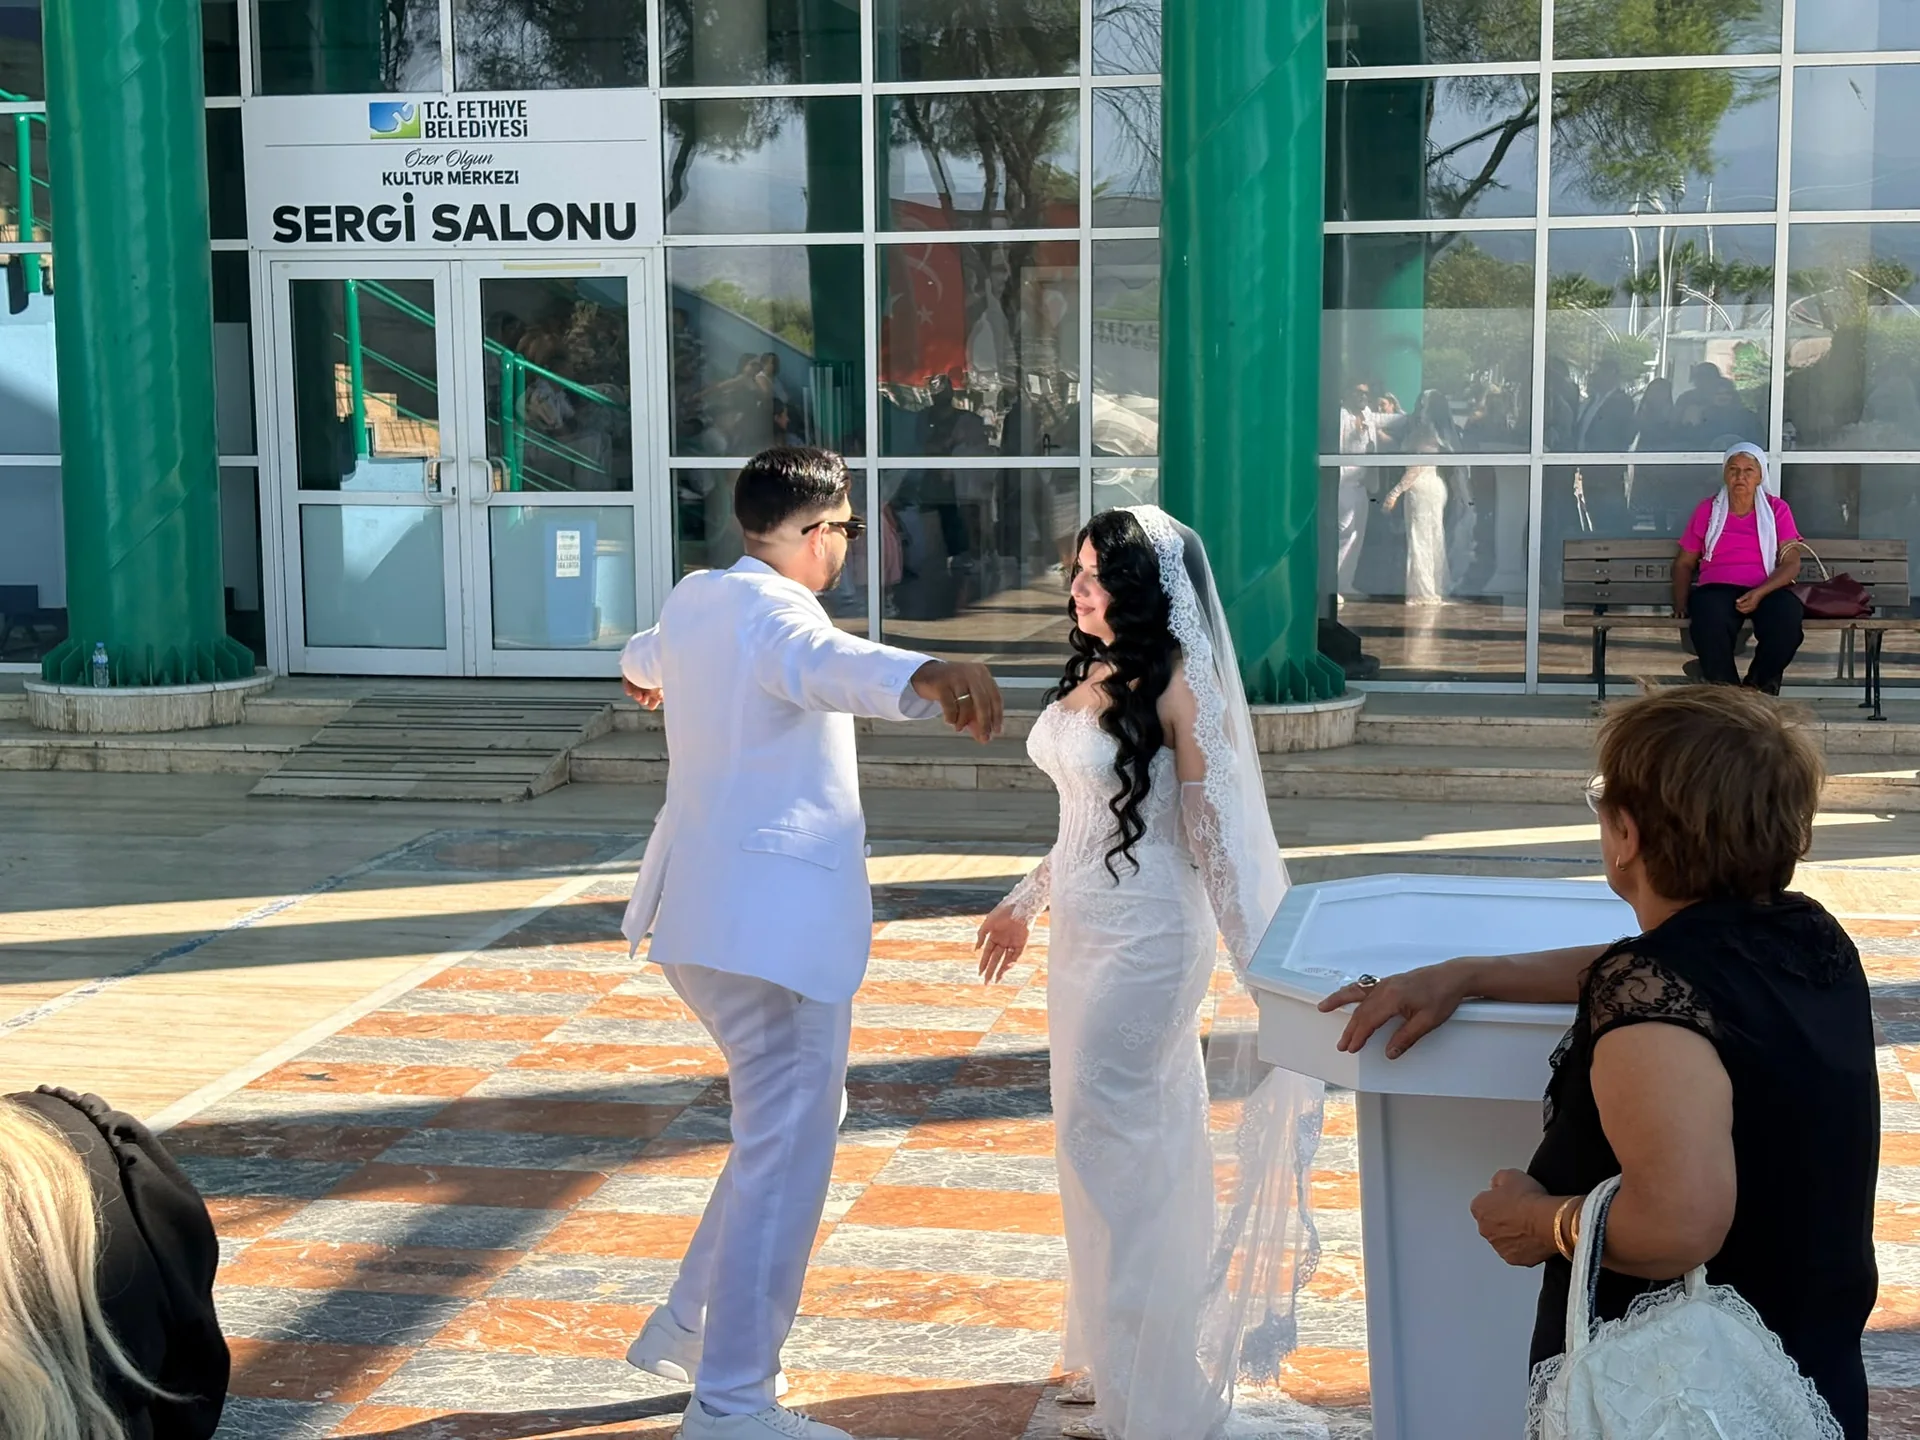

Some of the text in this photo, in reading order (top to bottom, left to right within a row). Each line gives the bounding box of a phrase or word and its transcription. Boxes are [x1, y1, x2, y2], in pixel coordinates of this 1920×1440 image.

[423, 100, 453, 119] T.C.
[404, 148, 494, 171] Özer Olgun
[272, 191, 637, 244] SERGİ SALONU
[1634, 564, 1673, 579] FET
